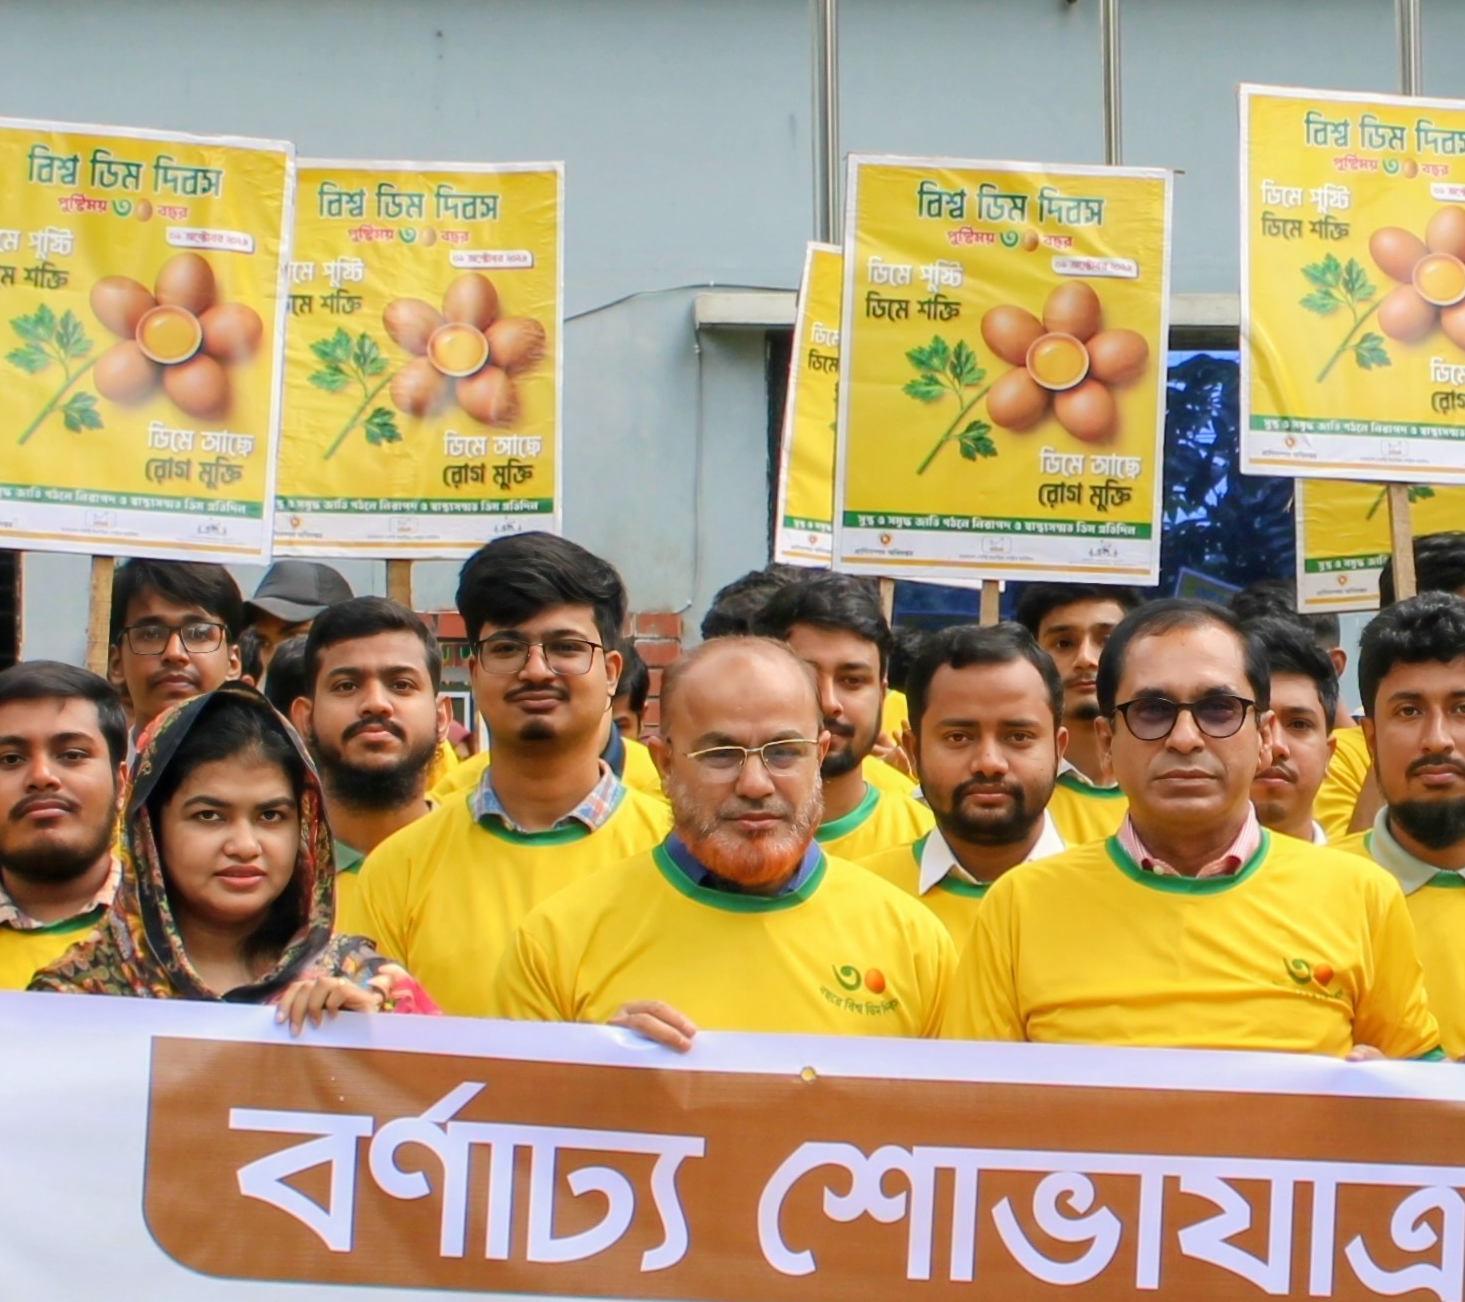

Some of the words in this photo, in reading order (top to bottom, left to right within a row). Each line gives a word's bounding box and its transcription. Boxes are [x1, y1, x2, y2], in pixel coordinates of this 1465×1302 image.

[1304, 110, 1350, 148] বিশ্ব
[1359, 114, 1406, 151] ডিম
[28, 145, 79, 186] বিশ্ব
[90, 149, 143, 191] ডিম
[153, 155, 223, 196] দিবস
[317, 182, 365, 218] বিশ্ব
[376, 183, 424, 219] ডিম
[435, 185, 499, 220] দিবস
[917, 180, 966, 220] বিশ্ব
[977, 183, 1028, 222] ডিম
[1038, 187, 1105, 225] দিবস
[1261, 179, 1303, 208] ডিমে
[1261, 211, 1303, 240] ডিমে
[1309, 213, 1350, 241] শক্তি
[24, 261, 69, 291] শক্তি
[867, 256, 912, 286] ডিমে
[320, 290, 363, 315] শক্তি
[865, 291, 910, 321] ডিমে
[917, 293, 961, 322] শক্তি
[147, 421, 194, 453] ডিমে
[201, 431, 254, 459] আছে
[443, 429, 486, 457] ডিমে
[493, 434, 542, 459] আছে
[145, 457, 190, 484] রোগ
[198, 456, 244, 490] মুক্তি
[443, 463, 485, 489] রোগ
[493, 458, 534, 490] মুক্তি
[1039, 446, 1084, 476] ডিমে
[1090, 452, 1141, 479] আছে
[1038, 481, 1082, 508] রোগ
[1089, 478, 1132, 512] মুক্তি
[228, 1081, 706, 1274] বর্ণাঢ্য
